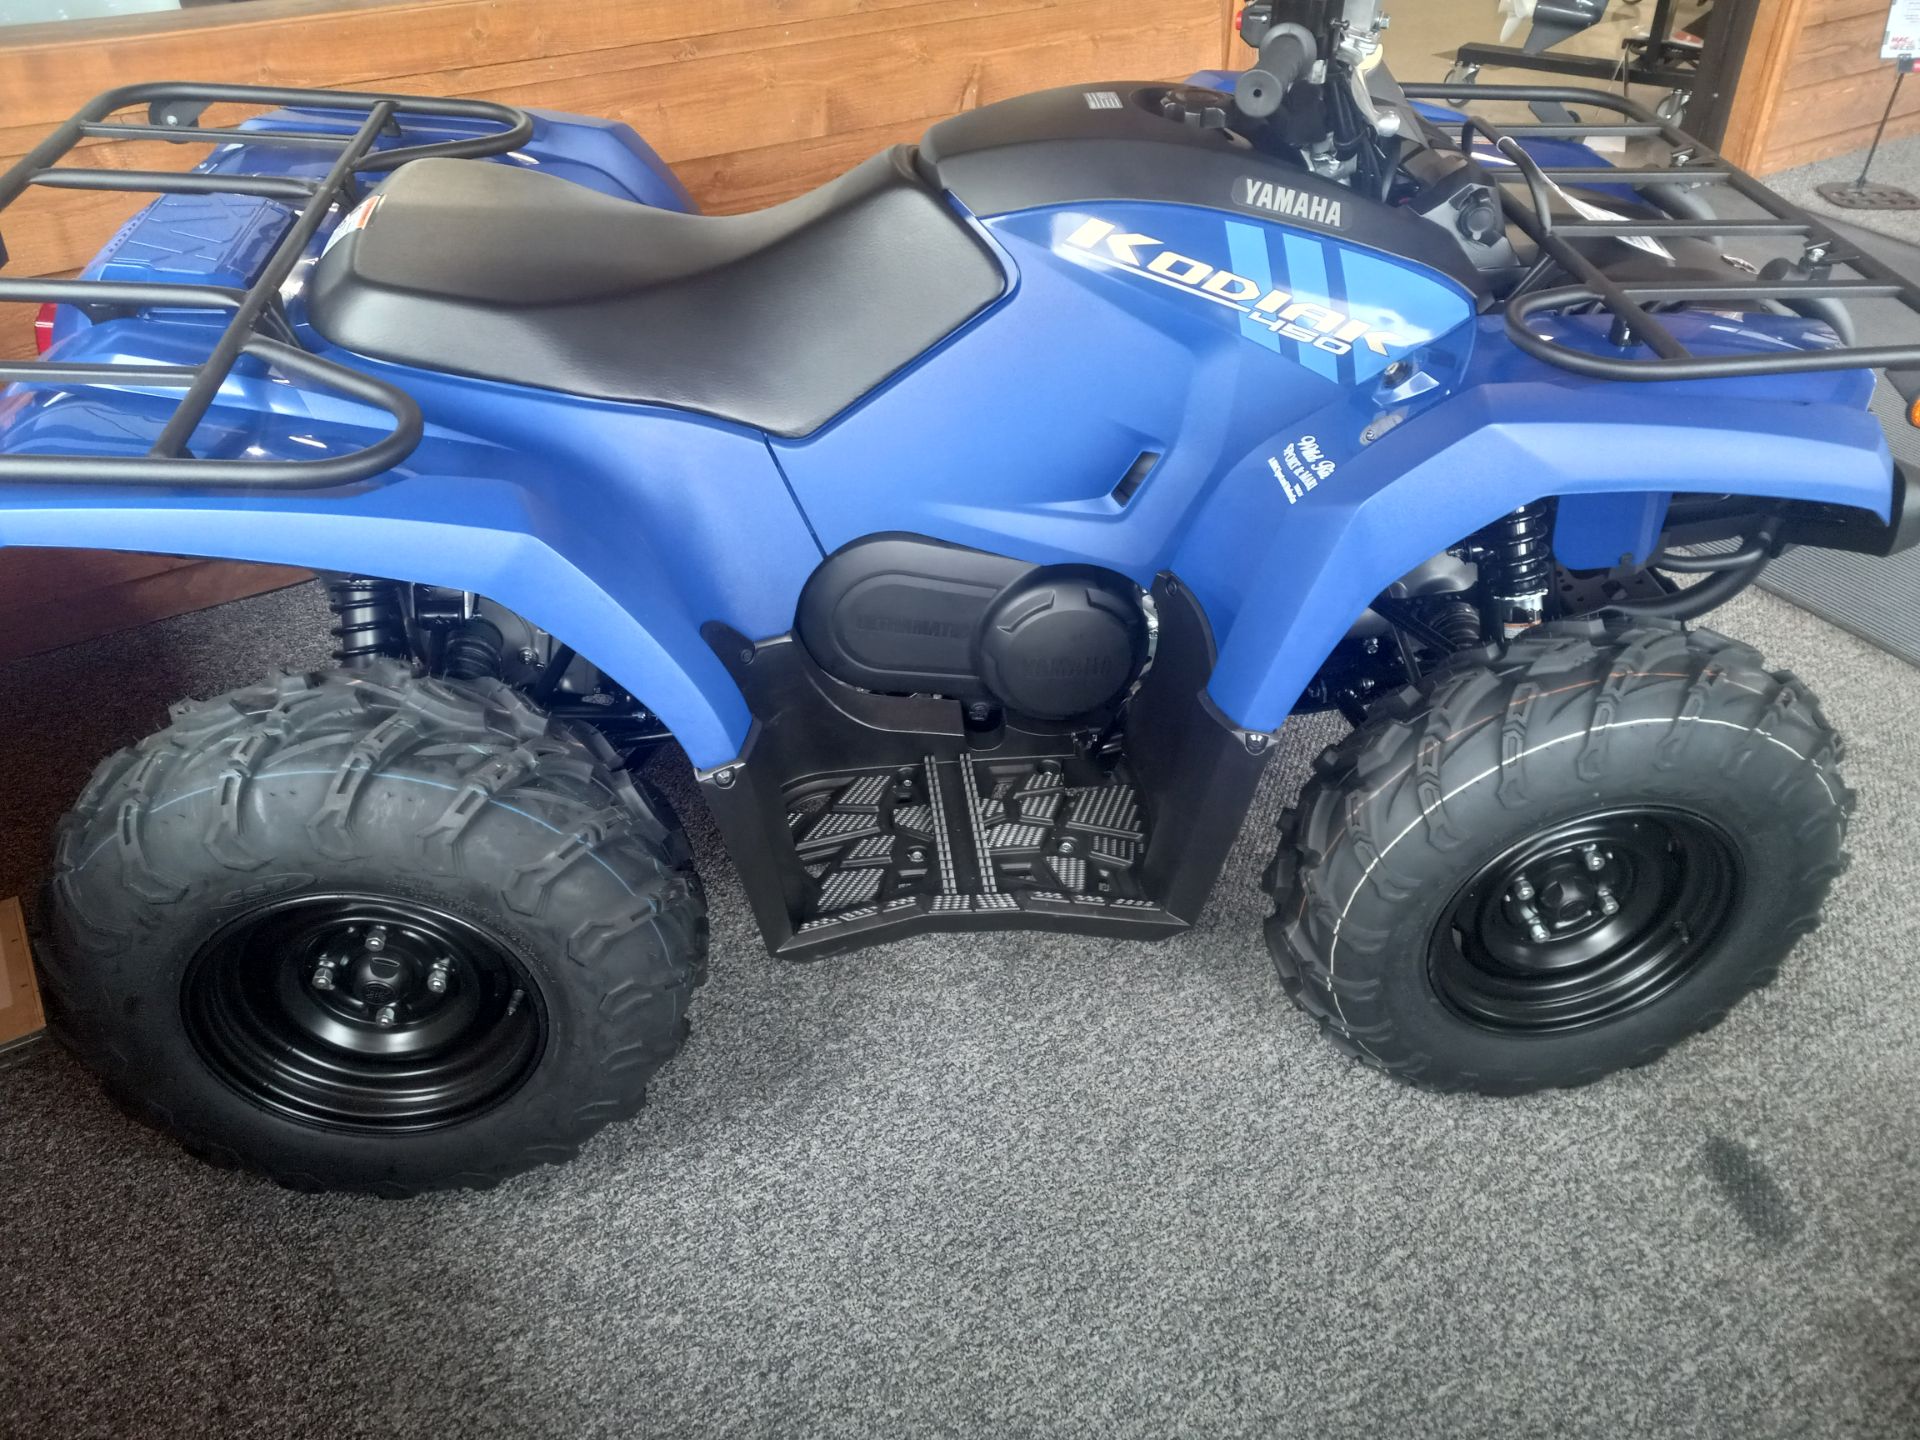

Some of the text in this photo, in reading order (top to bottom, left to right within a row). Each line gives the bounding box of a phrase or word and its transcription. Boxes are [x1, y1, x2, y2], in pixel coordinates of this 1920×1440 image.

[1246, 178, 1341, 227] YAMAHA
[1065, 217, 1416, 357] KODIAK
[1247, 311, 1352, 355] 450
